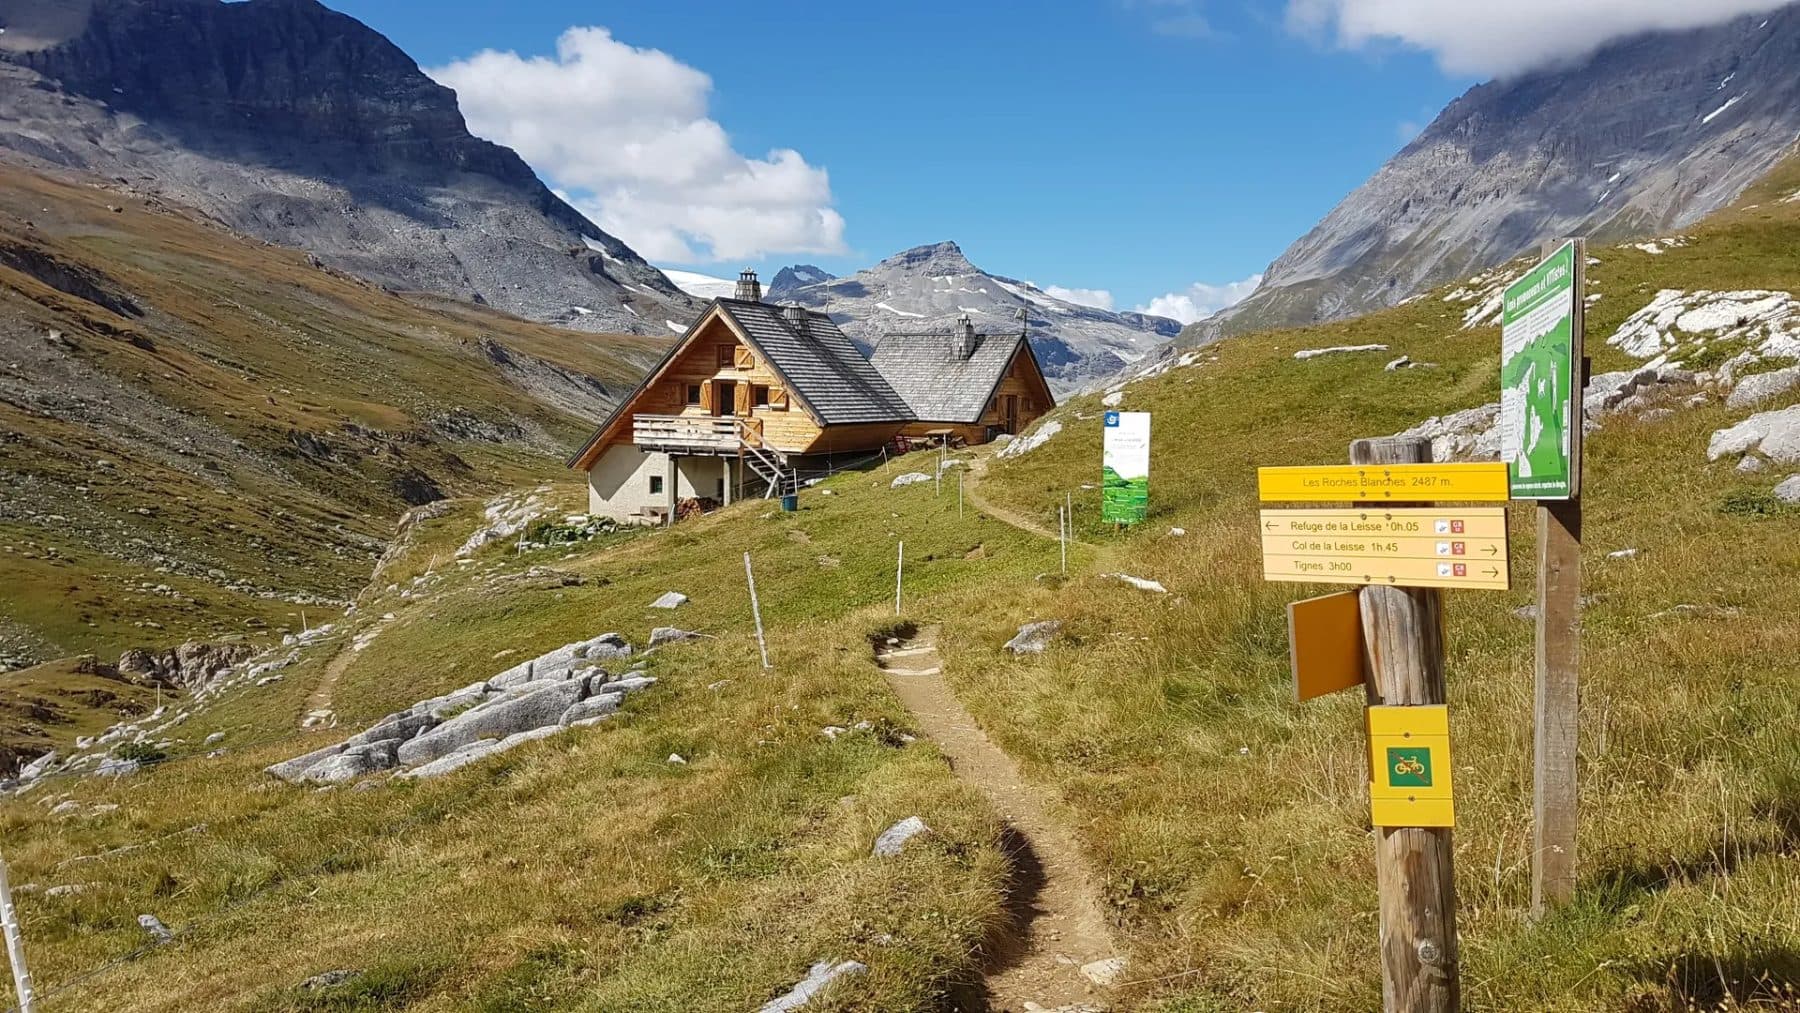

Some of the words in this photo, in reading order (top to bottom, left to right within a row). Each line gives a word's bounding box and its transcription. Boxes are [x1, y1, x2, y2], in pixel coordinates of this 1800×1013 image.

[1303, 478, 1320, 487] Les
[1322, 477, 1358, 487] Roches
[1360, 477, 1406, 487] Blanches
[1411, 477, 1437, 487] 2487
[1290, 521, 1322, 532] Refuge
[1325, 521, 1337, 531] de
[1339, 521, 1348, 531] la
[1351, 521, 1382, 532] Leisse
[1292, 541, 1307, 551] Col
[1310, 541, 1321, 551] de
[1323, 541, 1332, 551] la
[1334, 541, 1365, 551] Leisse
[1371, 542, 1398, 552] 1h.45
[1293, 560, 1323, 572] Tignes
[1328, 561, 1352, 572] 3h00
